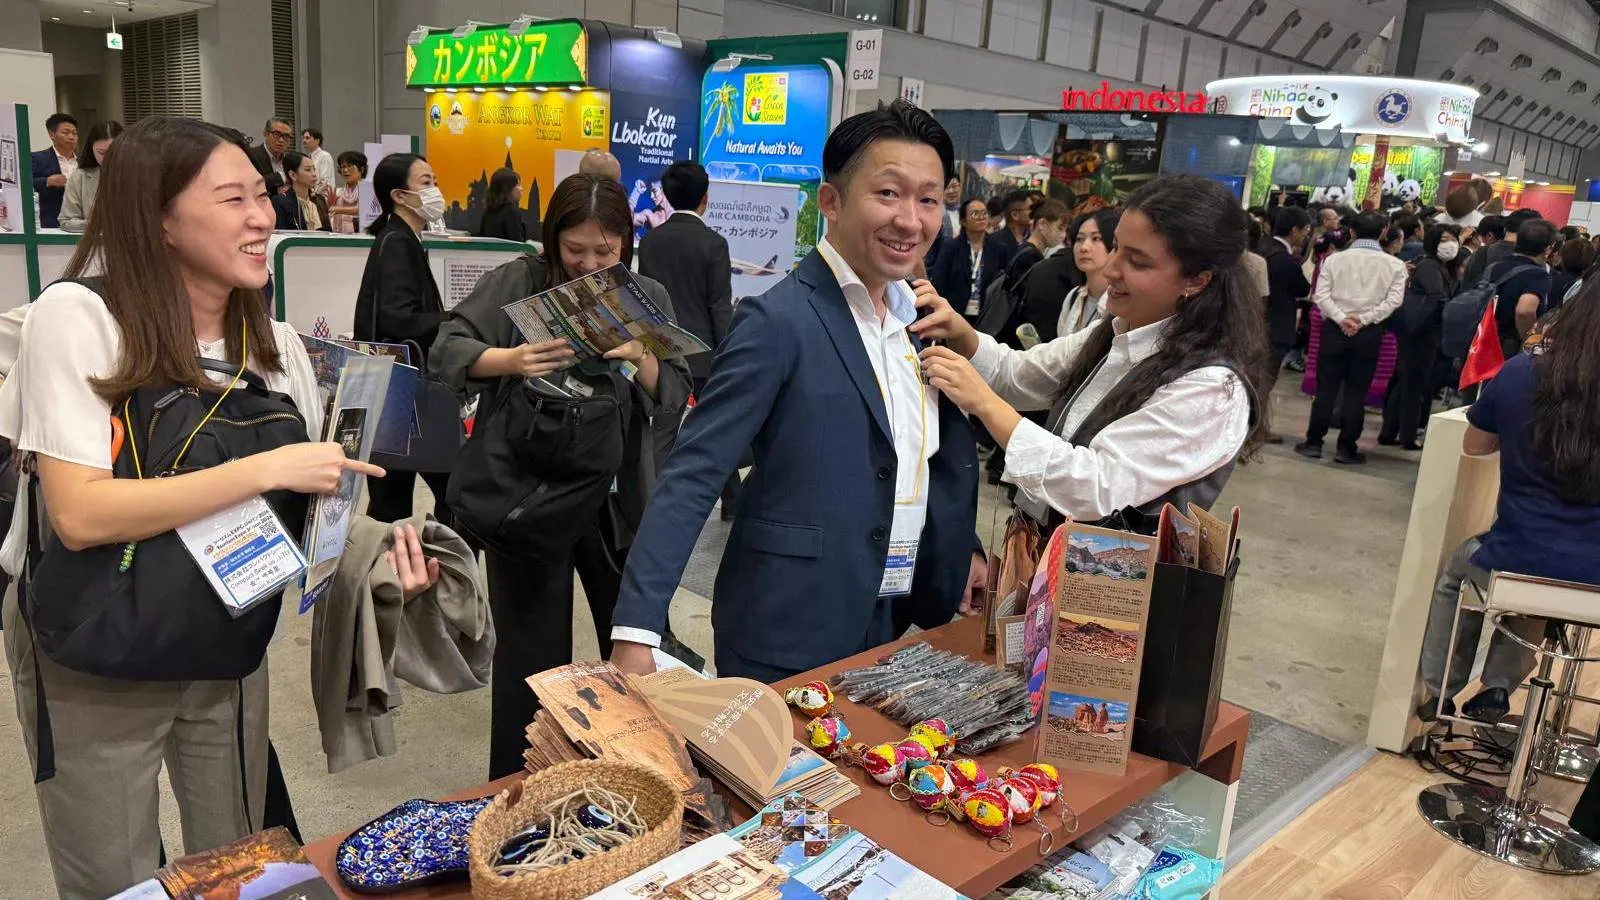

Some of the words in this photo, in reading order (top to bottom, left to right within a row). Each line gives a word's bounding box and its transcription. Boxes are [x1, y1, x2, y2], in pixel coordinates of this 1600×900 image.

[856, 40, 876, 50] G-01
[434, 33, 547, 82] カンボジア
[853, 69, 873, 80] G-02
[1062, 80, 1207, 112] indonesia
[1262, 88, 1307, 102] Nihao
[477, 104, 533, 125] ANGKOR
[534, 104, 564, 126] WAT
[1249, 103, 1293, 117] China
[646, 107, 676, 129] Kun
[611, 121, 677, 147] Lbokator
[640, 147, 673, 156] Traditional
[725, 139, 756, 154] Natural
[757, 140, 786, 155] Awaits
[787, 141, 803, 156] You
[638, 155, 659, 164] Martial
[660, 157, 673, 165] Arts
[708, 211, 724, 220] AIR
[724, 212, 770, 222] CAMBODIA
[713, 226, 778, 239] ア・カンボジア
